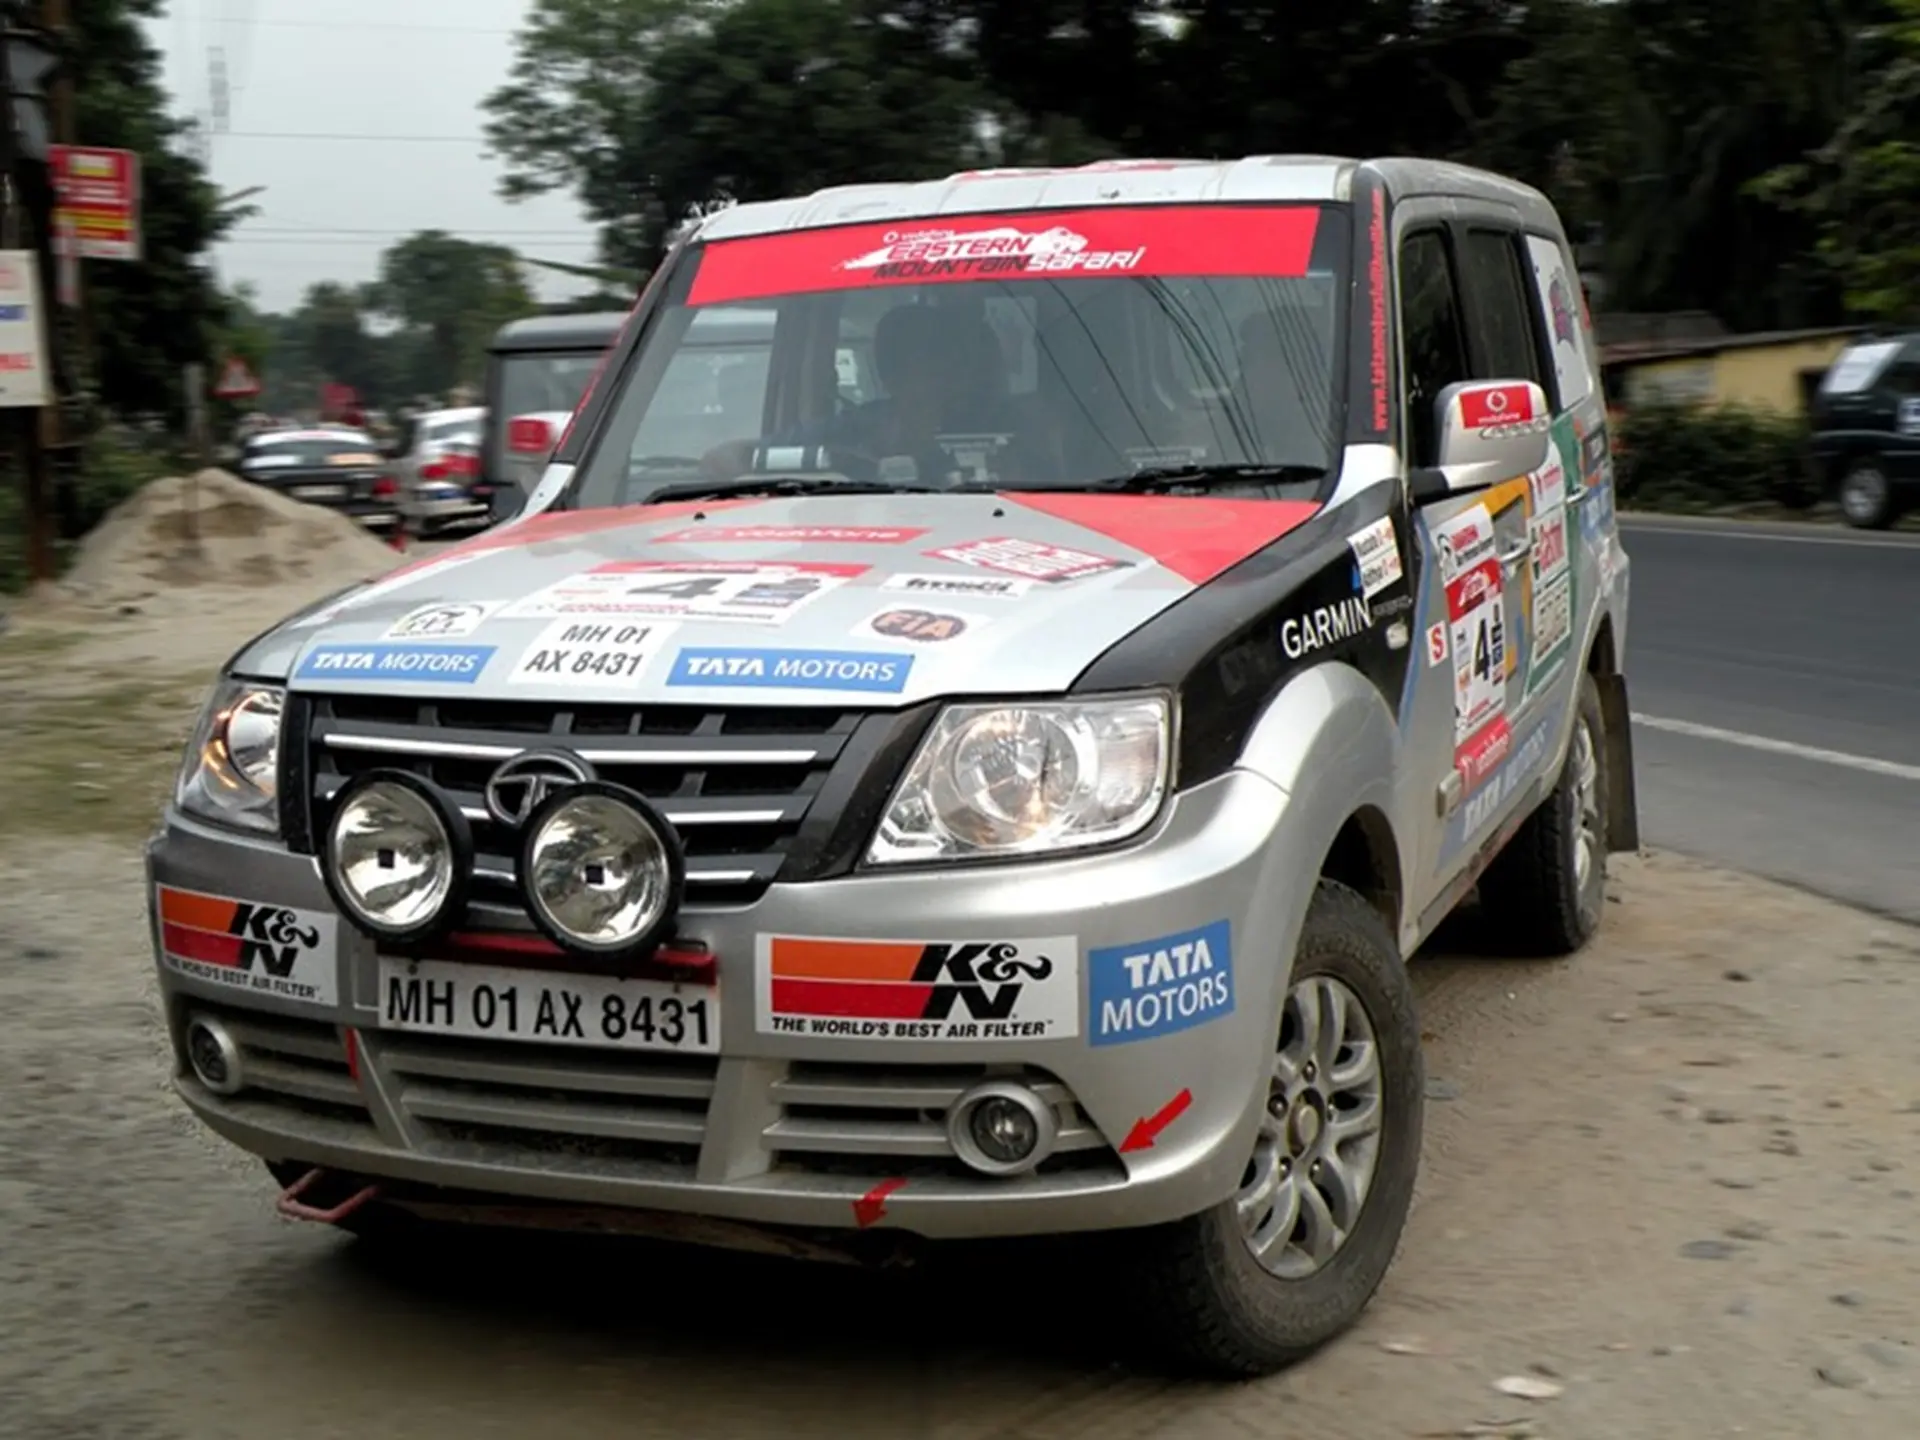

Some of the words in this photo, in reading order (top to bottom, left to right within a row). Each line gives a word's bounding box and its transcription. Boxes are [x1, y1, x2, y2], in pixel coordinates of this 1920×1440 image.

[626, 577, 728, 599] 4
[560, 625, 611, 643] MH
[614, 626, 652, 645] 01
[874, 611, 955, 638] FIA
[1280, 596, 1374, 659] GARMIN
[1431, 626, 1444, 661] S
[1474, 618, 1490, 681] 4
[312, 652, 374, 670] TATA
[378, 651, 480, 674] MOTORS
[524, 650, 573, 673] AX
[573, 651, 645, 677] 8431
[686, 656, 765, 677] TATA
[773, 658, 897, 683] MOTORS
[228, 902, 320, 978] K&N
[1122, 938, 1214, 990] TATA
[222, 971, 249, 987] BEST
[251, 975, 272, 991] AIR
[911, 942, 1053, 1020] K&N
[386, 976, 455, 1026] MH
[471, 985, 518, 1034] 01
[533, 990, 584, 1038] AX
[600, 992, 711, 1045] 8431
[1101, 971, 1230, 1035] MOTORS
[771, 1016, 805, 1032] THE
[811, 1019, 890, 1036] WORLD'S
[894, 1022, 941, 1037] BEST
[947, 1023, 979, 1038] AIR
